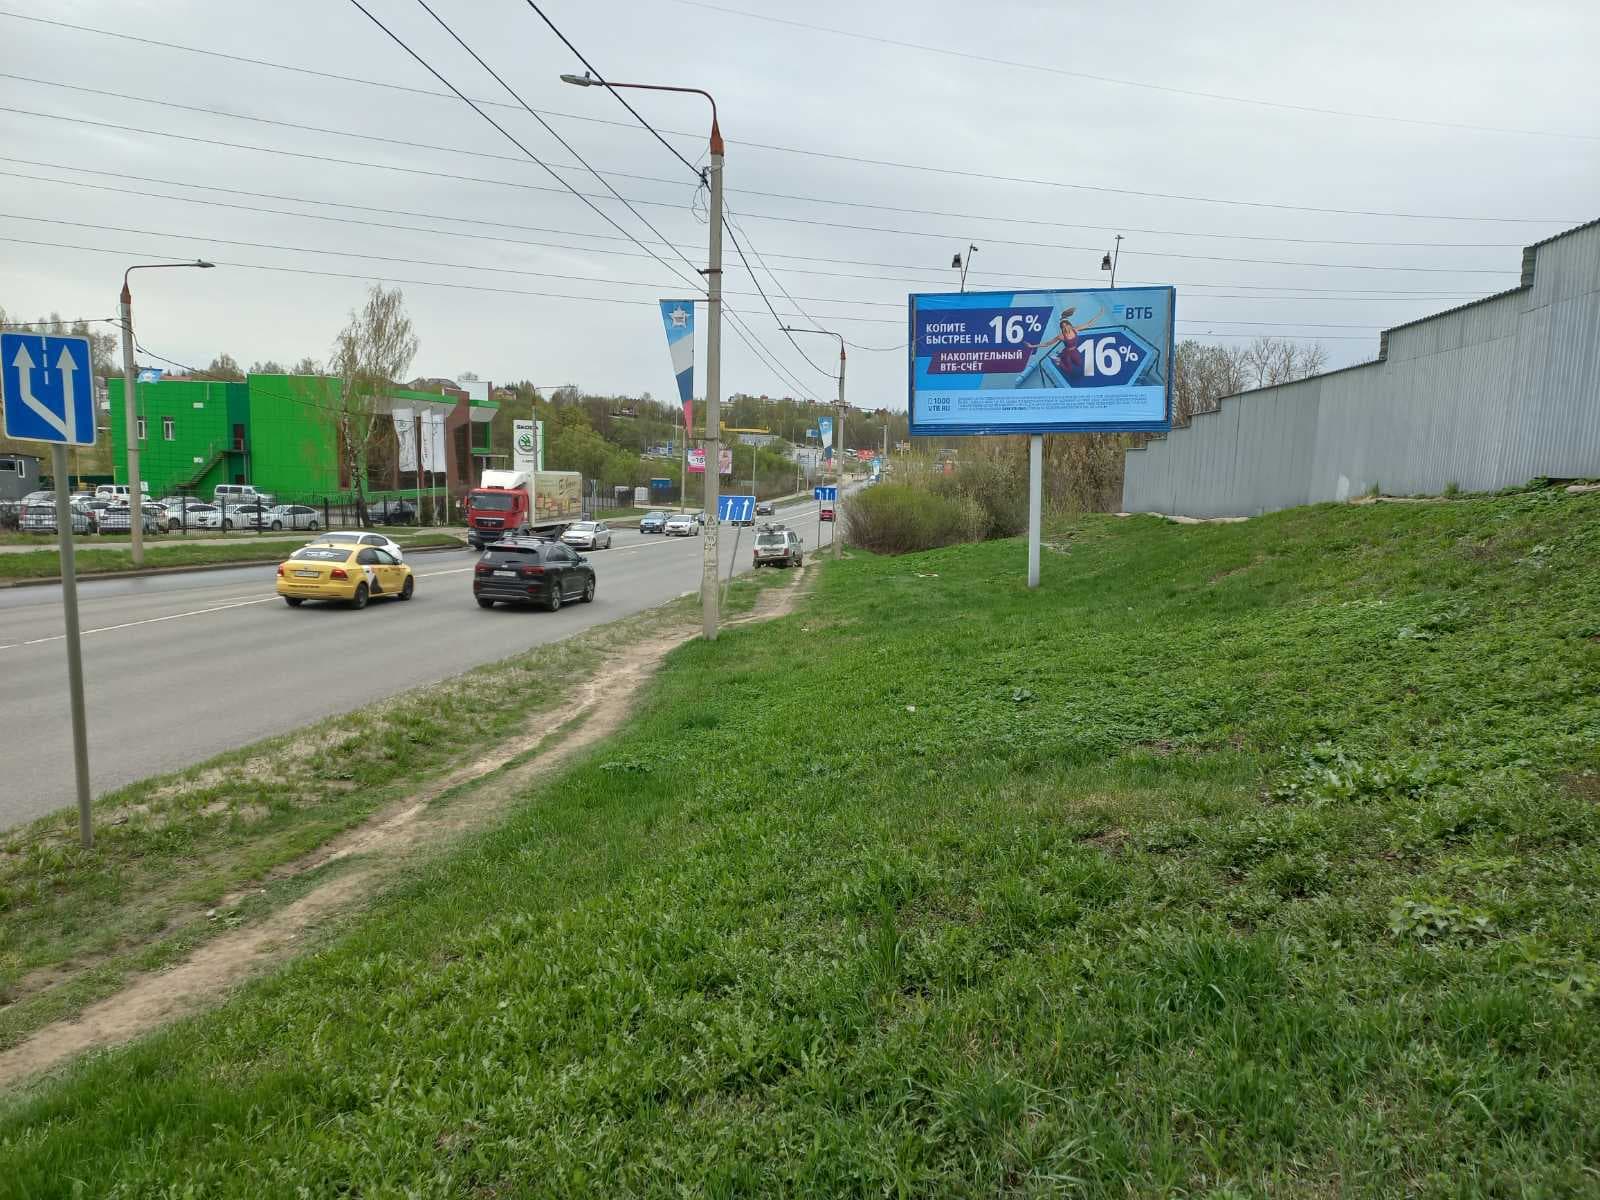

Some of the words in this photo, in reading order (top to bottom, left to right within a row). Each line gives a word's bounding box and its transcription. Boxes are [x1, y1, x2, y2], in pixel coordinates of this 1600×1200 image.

[1125, 306, 1153, 320] ВТБ
[926, 322, 966, 333] КОПИТЕ
[926, 334, 972, 345] БЫСТРЕЕ
[974, 334, 989, 344] НА
[988, 314, 1042, 344] 16%
[940, 350, 1023, 361] НАКОПИТЕЛЬНЫЙ
[1077, 336, 1139, 377] 16%
[940, 361, 983, 372] ВТБ-СЧЁТ
